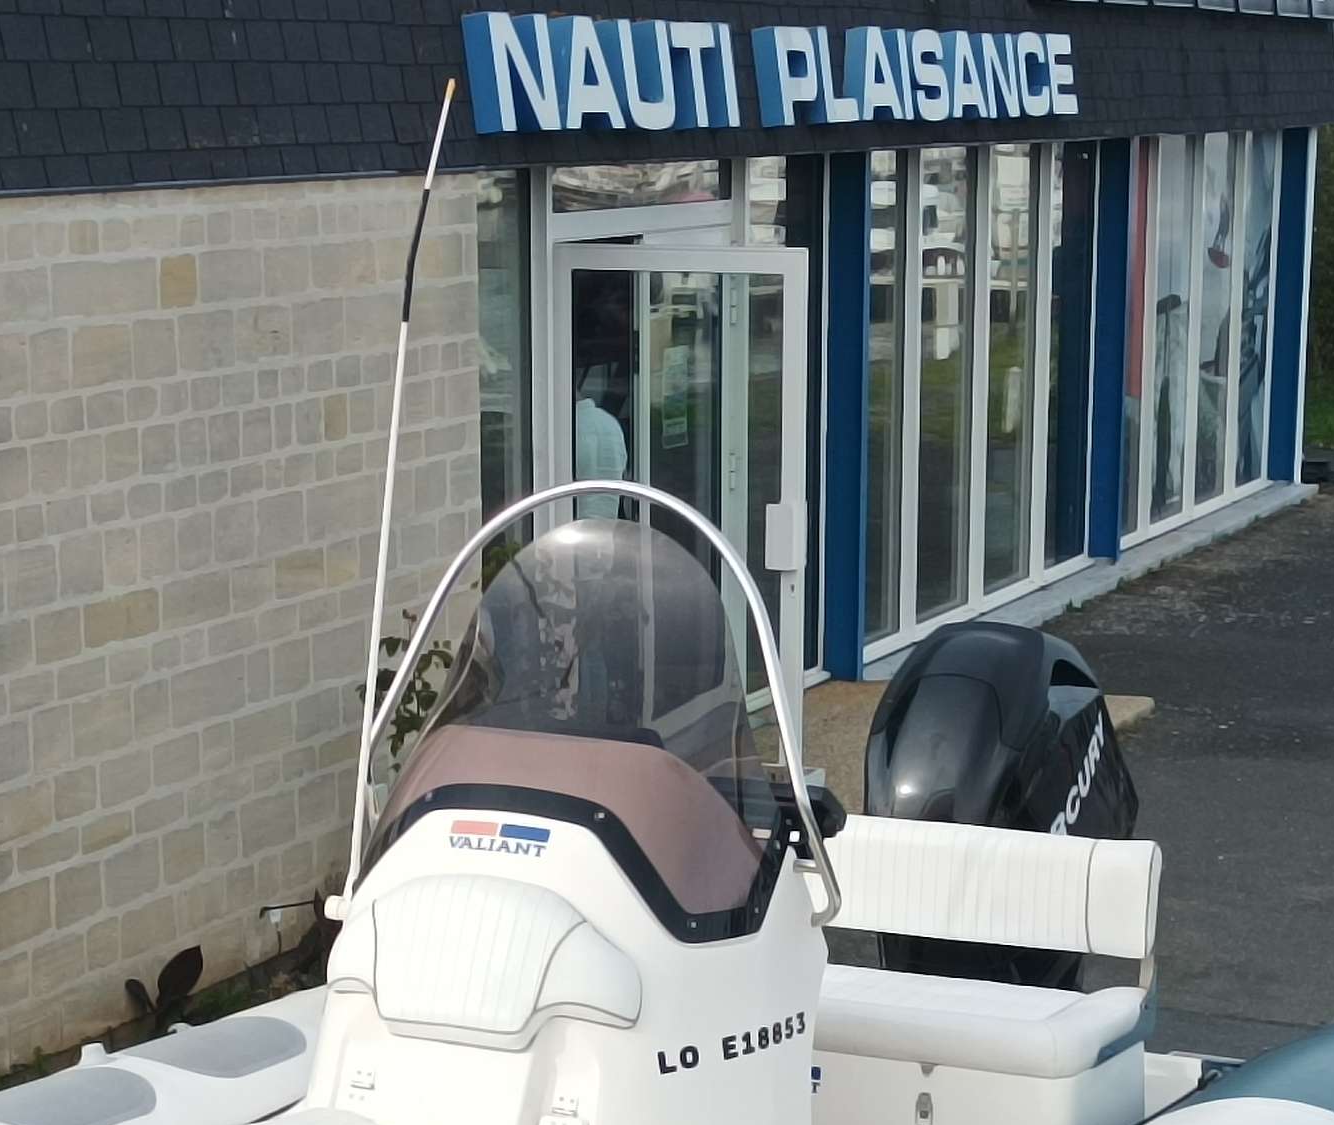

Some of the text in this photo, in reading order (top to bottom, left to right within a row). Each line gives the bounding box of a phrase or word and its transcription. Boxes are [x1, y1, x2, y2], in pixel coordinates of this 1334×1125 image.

[464, 11, 1079, 134] NAUTI PLAISANCE
[1050, 711, 1105, 836] RCURY
[448, 836, 547, 857] VALIANT
[657, 1011, 806, 1075] LO E18853
